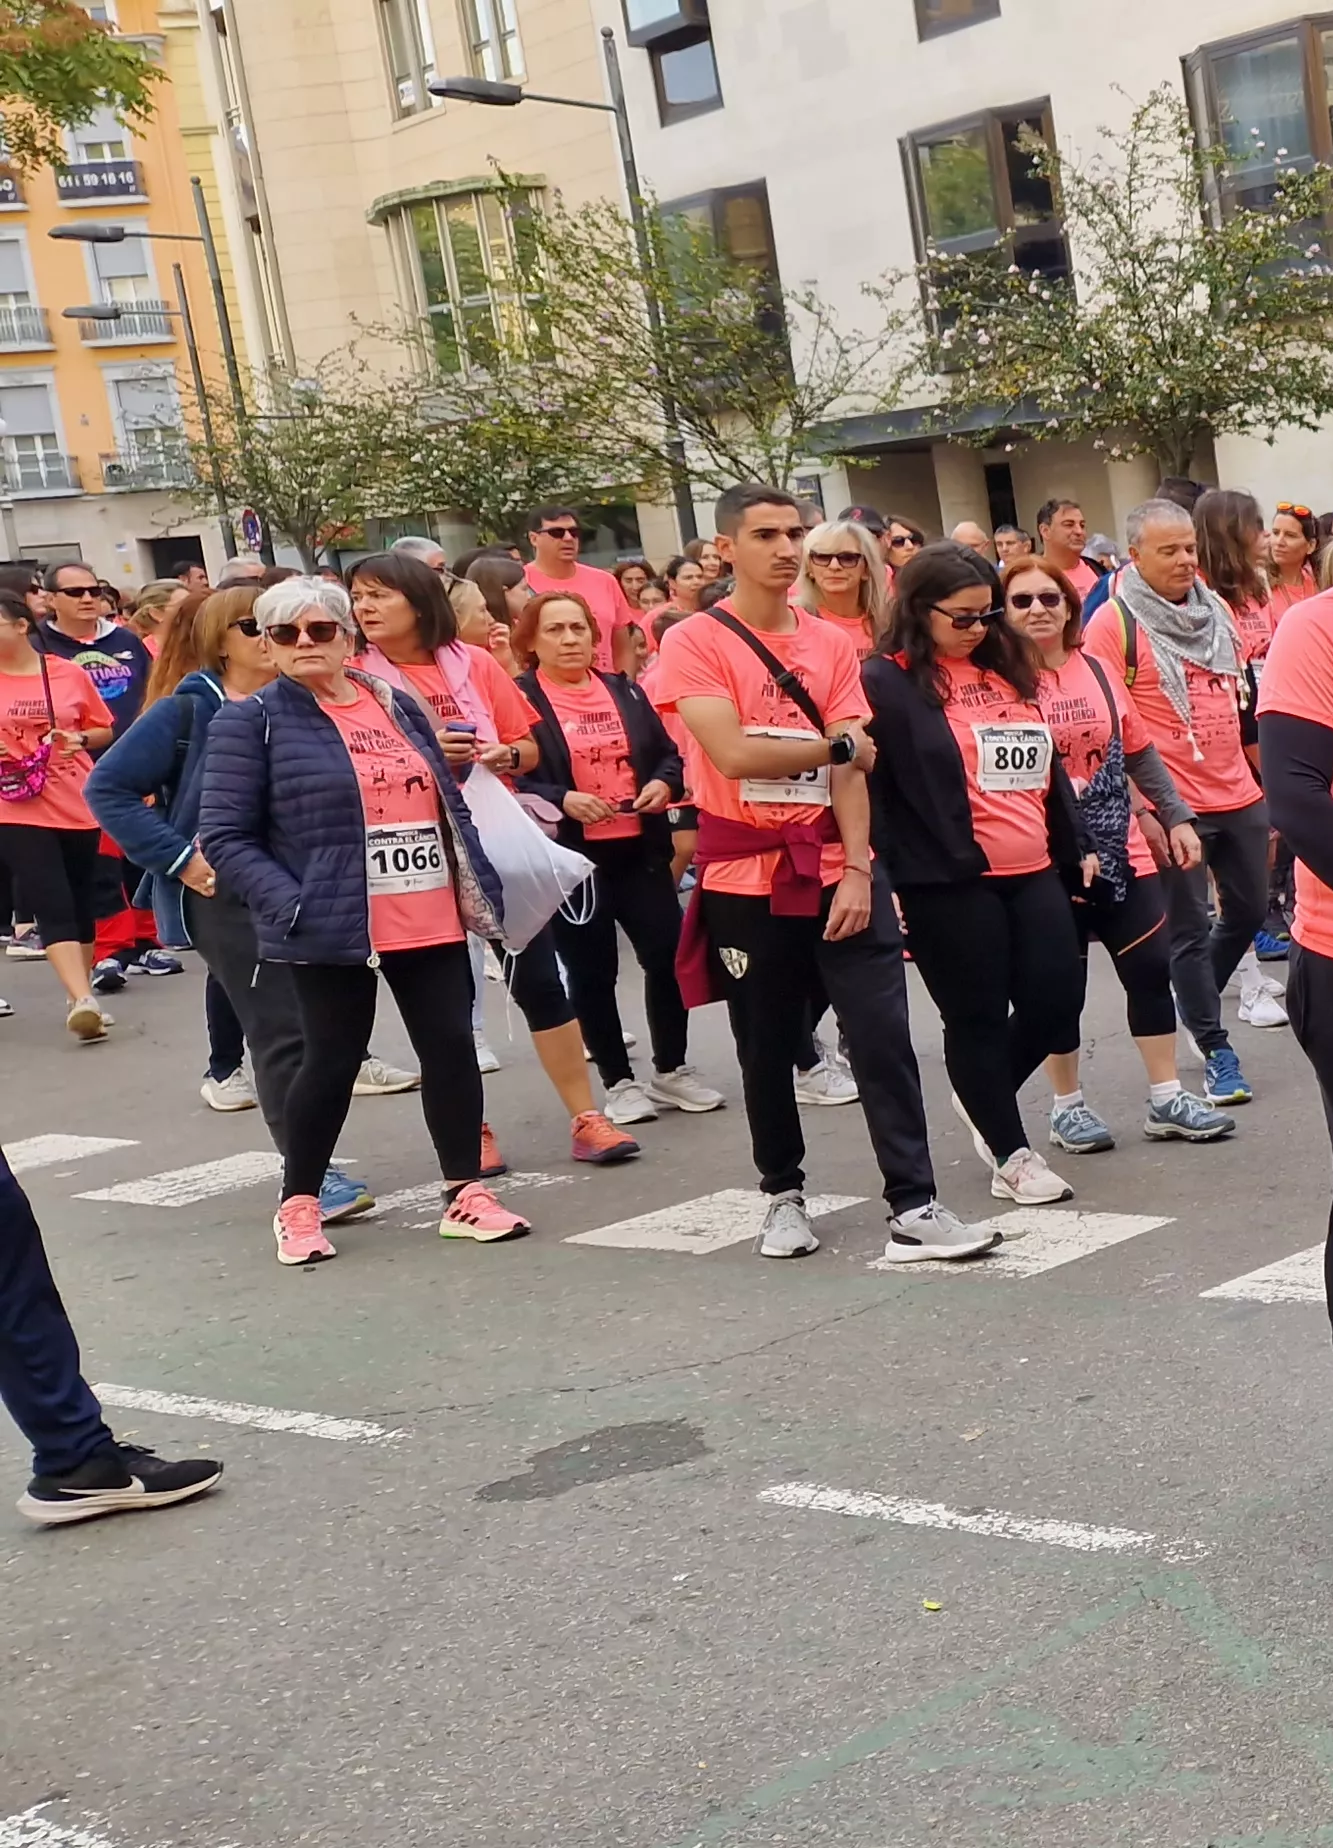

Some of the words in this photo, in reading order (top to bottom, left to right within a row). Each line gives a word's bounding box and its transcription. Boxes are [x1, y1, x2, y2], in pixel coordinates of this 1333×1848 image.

[1052, 697, 1088, 711] CORRAMOS
[1048, 714, 1061, 726] POR
[1062, 712, 1070, 723] LA
[1072, 708, 1096, 721] CIENCIA
[994, 746, 1038, 770] 808
[368, 835, 403, 846] CONTRA
[405, 834, 414, 843] EL
[371, 844, 440, 874] 1066
